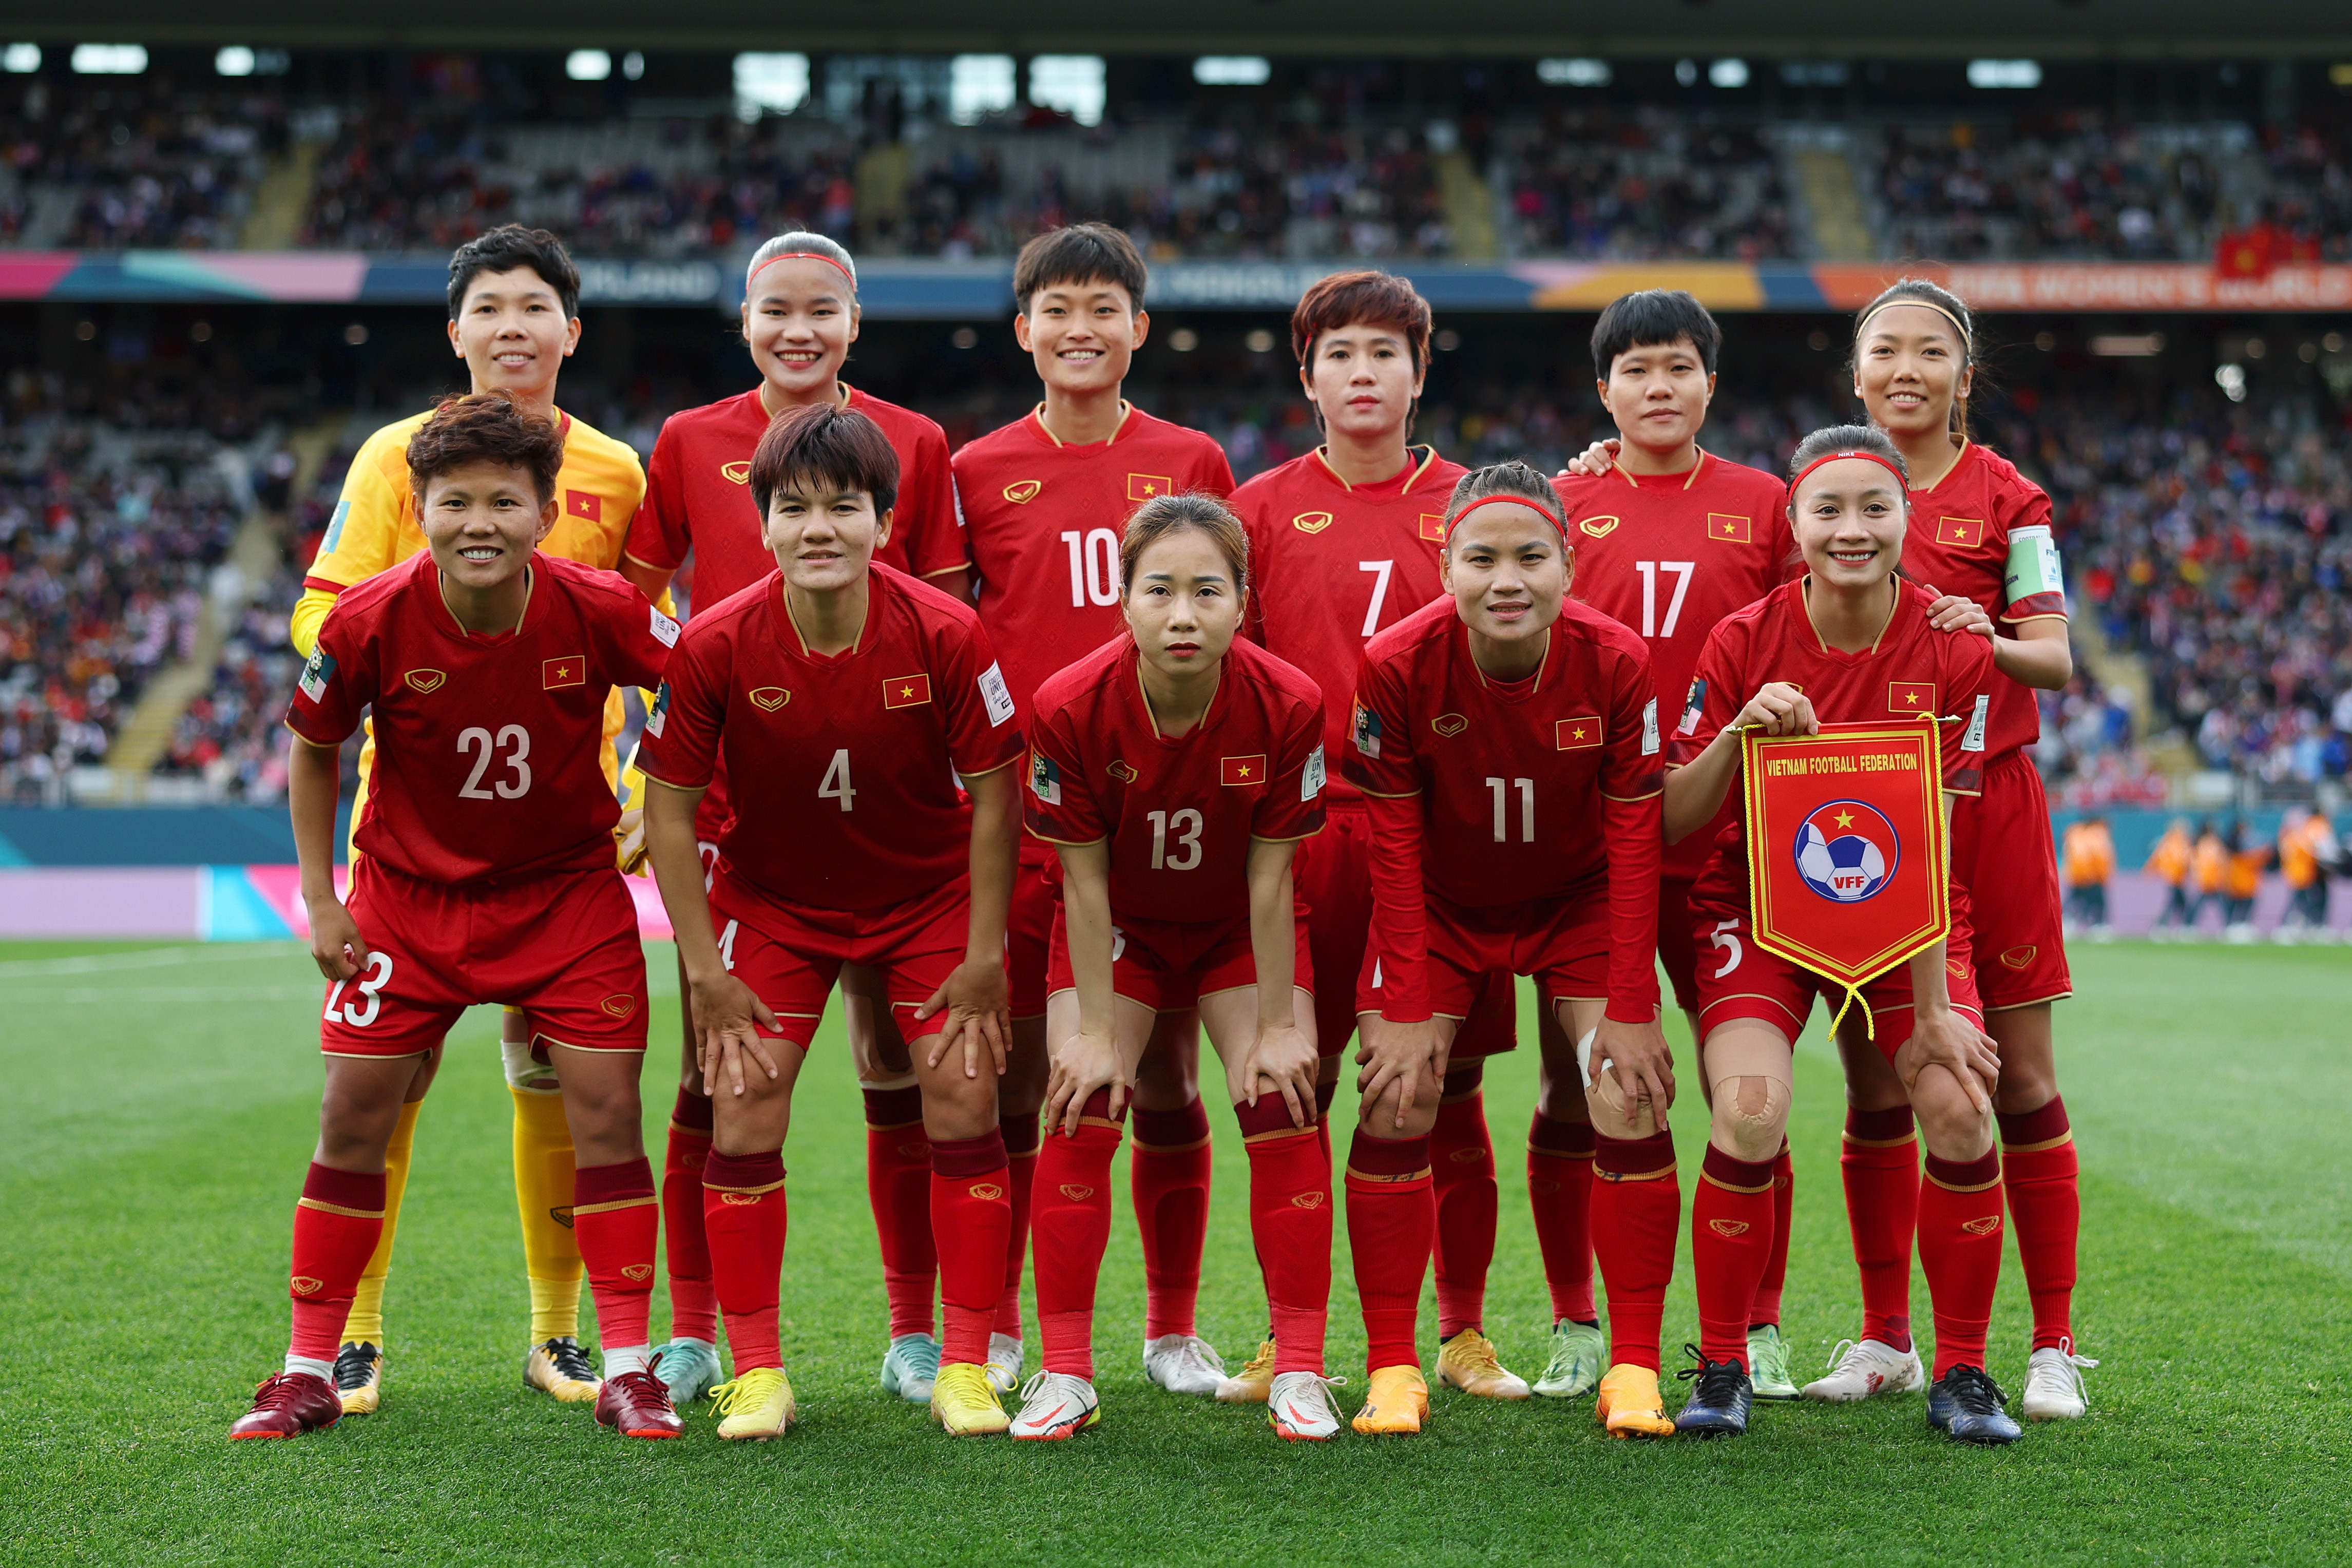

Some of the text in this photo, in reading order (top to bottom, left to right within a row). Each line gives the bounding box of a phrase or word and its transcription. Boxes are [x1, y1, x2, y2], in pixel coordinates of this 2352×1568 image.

[1061, 528, 1120, 607] 10
[1359, 560, 1393, 637] 7
[1636, 561, 1695, 637] 17
[457, 724, 531, 800] 23
[818, 749, 856, 812] 4
[1766, 753, 1917, 776] VIETNAM FOOTBALL FEDERATION
[1147, 808, 1203, 870] 13
[1486, 777, 1534, 842] 11
[1833, 876, 1864, 889] VFF
[1710, 918, 1742, 979] 5
[323, 951, 393, 1027] 23
